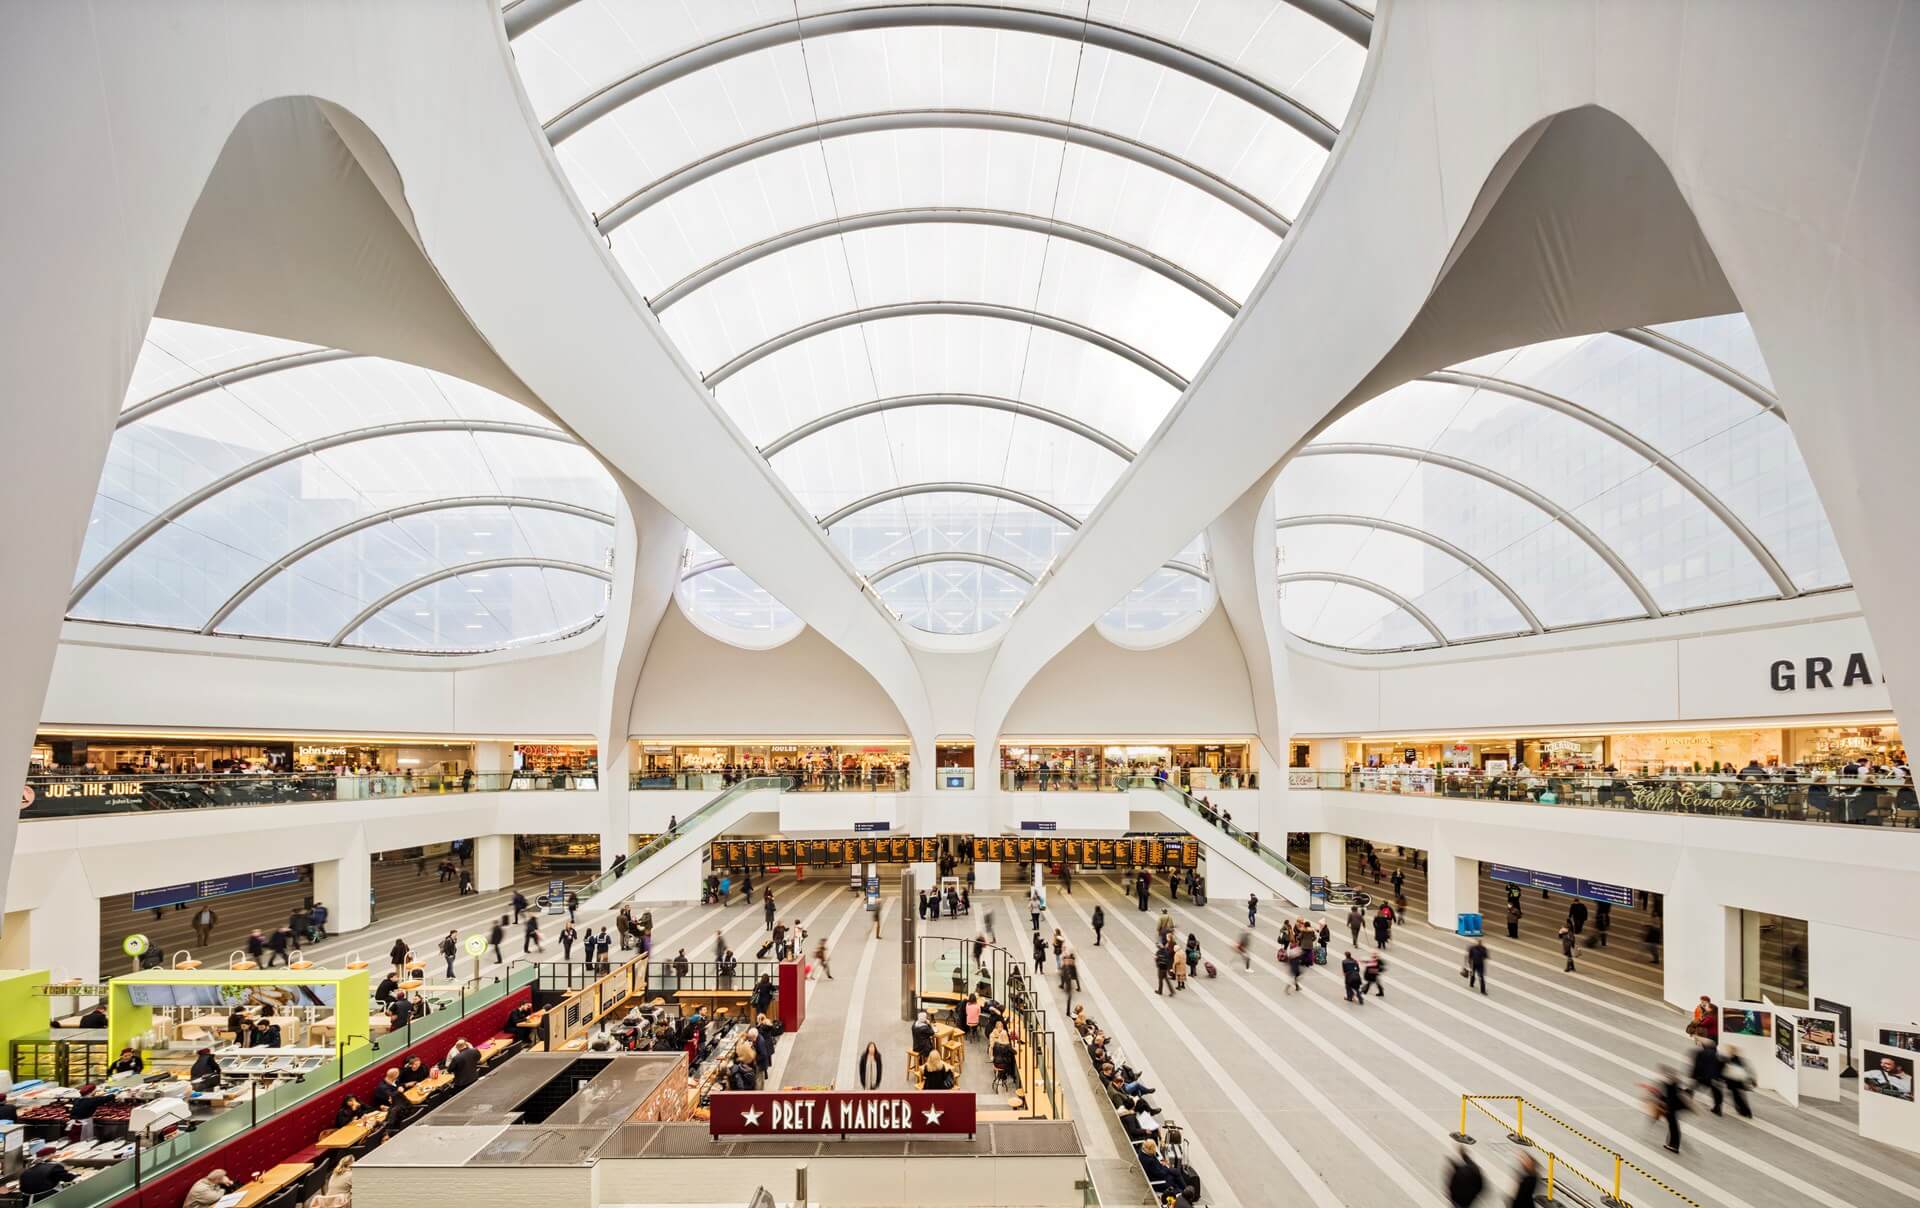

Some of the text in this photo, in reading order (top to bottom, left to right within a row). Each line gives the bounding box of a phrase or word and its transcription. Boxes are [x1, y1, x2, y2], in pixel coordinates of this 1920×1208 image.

[1770, 653, 1886, 692] GRA
[299, 746, 346, 755] John Lewis
[517, 745, 560, 756] FOYLES
[45, 783, 72, 797] JOE
[83, 783, 106, 796] THE
[109, 782, 143, 795] JUICE
[1677, 790, 1759, 810] Concerto
[772, 1099, 913, 1130] PRET A MANGER
